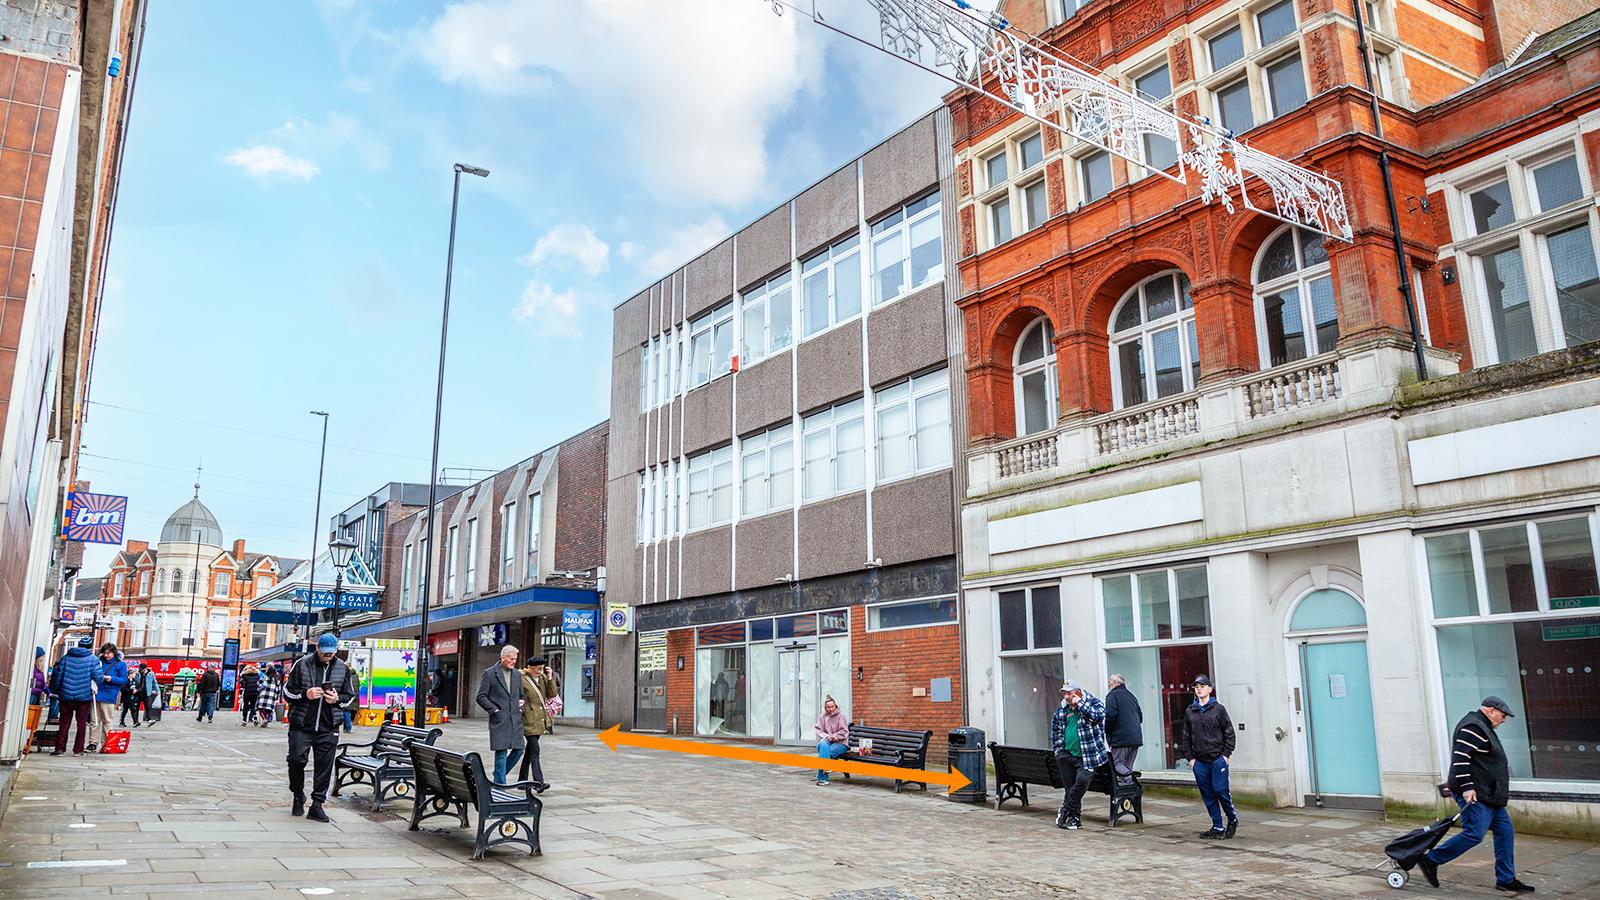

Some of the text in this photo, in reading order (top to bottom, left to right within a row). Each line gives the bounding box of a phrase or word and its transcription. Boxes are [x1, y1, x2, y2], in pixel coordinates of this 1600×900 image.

[75, 508, 121, 526] b&m
[312, 593, 373, 603] SWASGATE
[564, 617, 593, 625] HALIFAX
